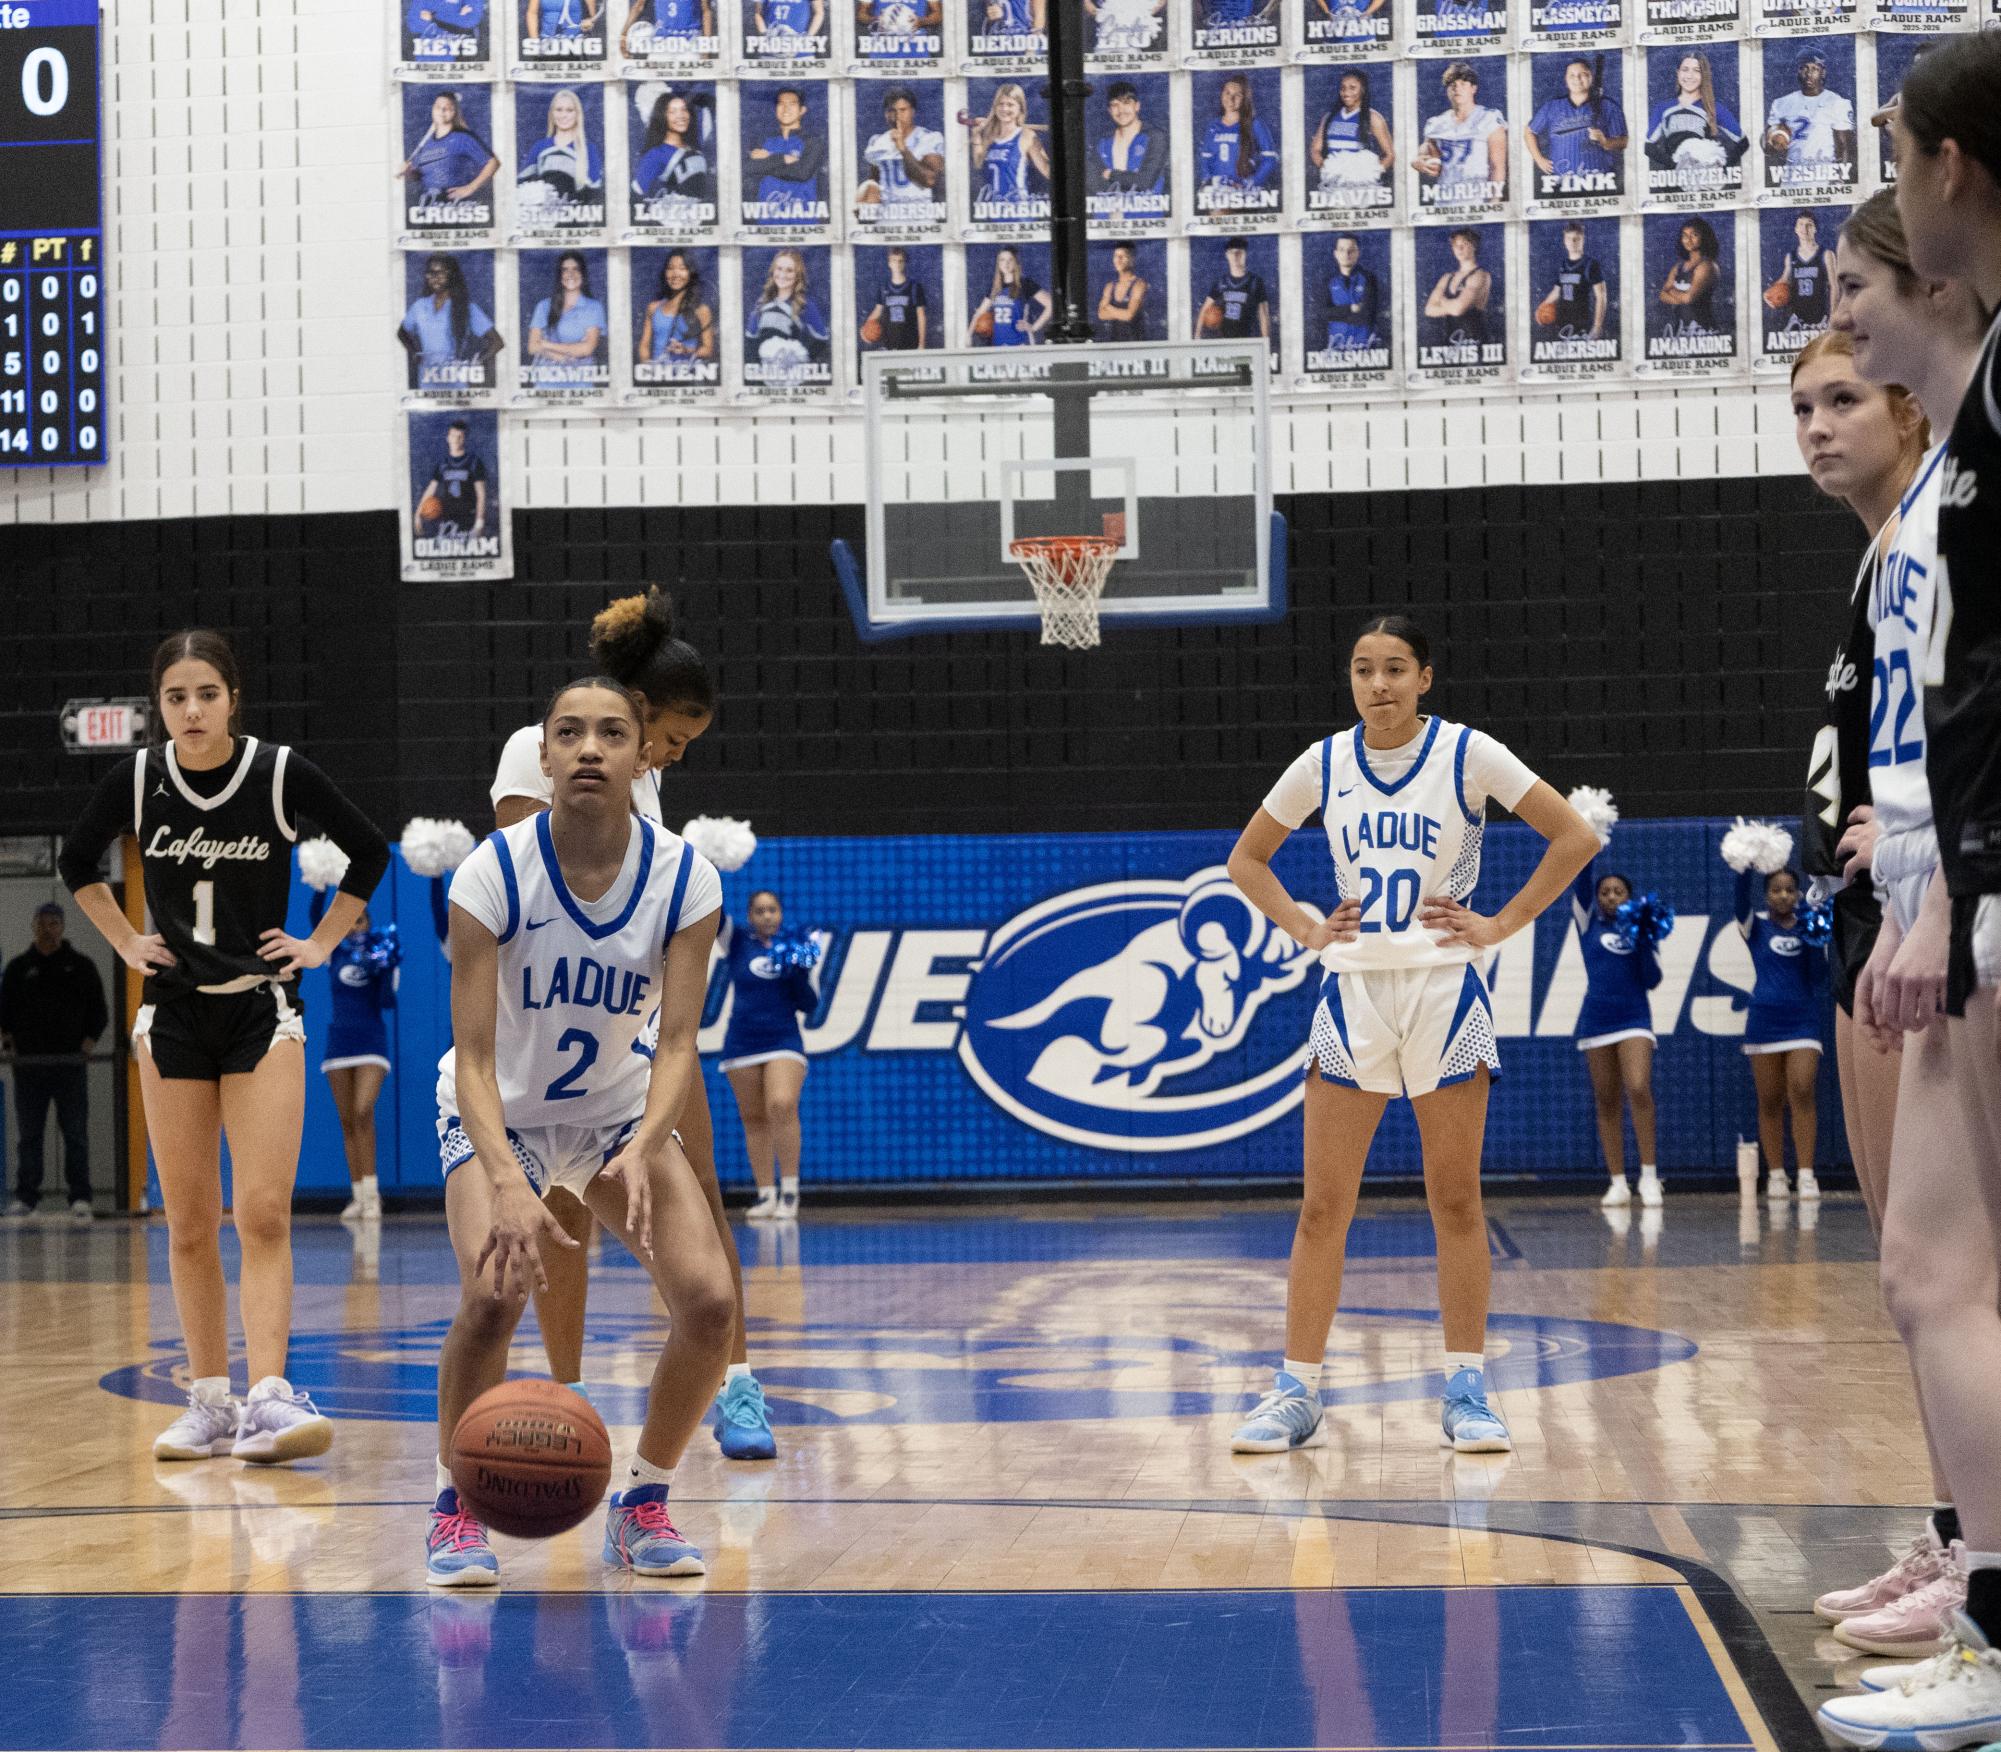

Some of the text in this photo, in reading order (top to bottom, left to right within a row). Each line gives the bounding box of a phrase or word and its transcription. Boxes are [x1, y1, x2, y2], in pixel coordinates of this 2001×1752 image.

[668, 2, 677, 17] 3
[1532, 3, 1621, 26] PLASSMEYER
[1883, 14, 1961, 23] LADUE RAMS
[1308, 18, 1390, 39] HWANG
[1416, 10, 1506, 32] GROSSMAN
[1654, 22, 1734, 36] LADUE RAMS
[1770, 15, 1851, 28] LADUE RAMS
[413, 37, 478, 56] KEYS
[522, 37, 602, 56] SONG
[1195, 26, 1278, 48] PERKINS
[1423, 36, 1501, 48] LADUE RAMS
[1537, 30, 1616, 42] LADUE RAMS
[1242, 48, 1276, 58] RAMS
[1354, 43, 1388, 53] RAMS
[21, 46, 69, 117] 0
[1541, 172, 1617, 194] FINK
[1769, 162, 1853, 184] WESLEY
[1198, 190, 1279, 210] ROSEN
[1309, 186, 1393, 208] DAVIS
[1422, 180, 1505, 202] MURPHY
[1656, 191, 1736, 203] LADUE RAMS
[1772, 185, 1853, 198] LADUE RAMS
[1469, 203, 1505, 213] RAMS
[1540, 197, 1619, 210] LADUE RAMS
[408, 205, 490, 225] CROSS
[0, 237, 94, 264] # PT f
[2, 274, 98, 302] 0 0 0
[4, 311, 95, 337] 1 0 1
[1419, 343, 1504, 366] LEWIS III
[1533, 339, 1618, 360] ANDERSON
[4, 350, 98, 374] 5 0 0
[634, 364, 718, 382] CHEN
[1580, 362, 1614, 373] RAMS
[1653, 358, 1730, 370] LADUE RAMS
[1, 389, 97, 414] 11 0 0
[0, 427, 97, 452] 14 0 0
[1868, 648, 1924, 769] 22
[86, 709, 124, 743] EXIT
[144, 824, 270, 870] Lafayette
[1342, 810, 1442, 865] LADUE
[1359, 866, 1421, 934] 20
[192, 880, 217, 946] 1
[522, 956, 652, 1016] LADUE
[543, 1027, 600, 1101] 2
